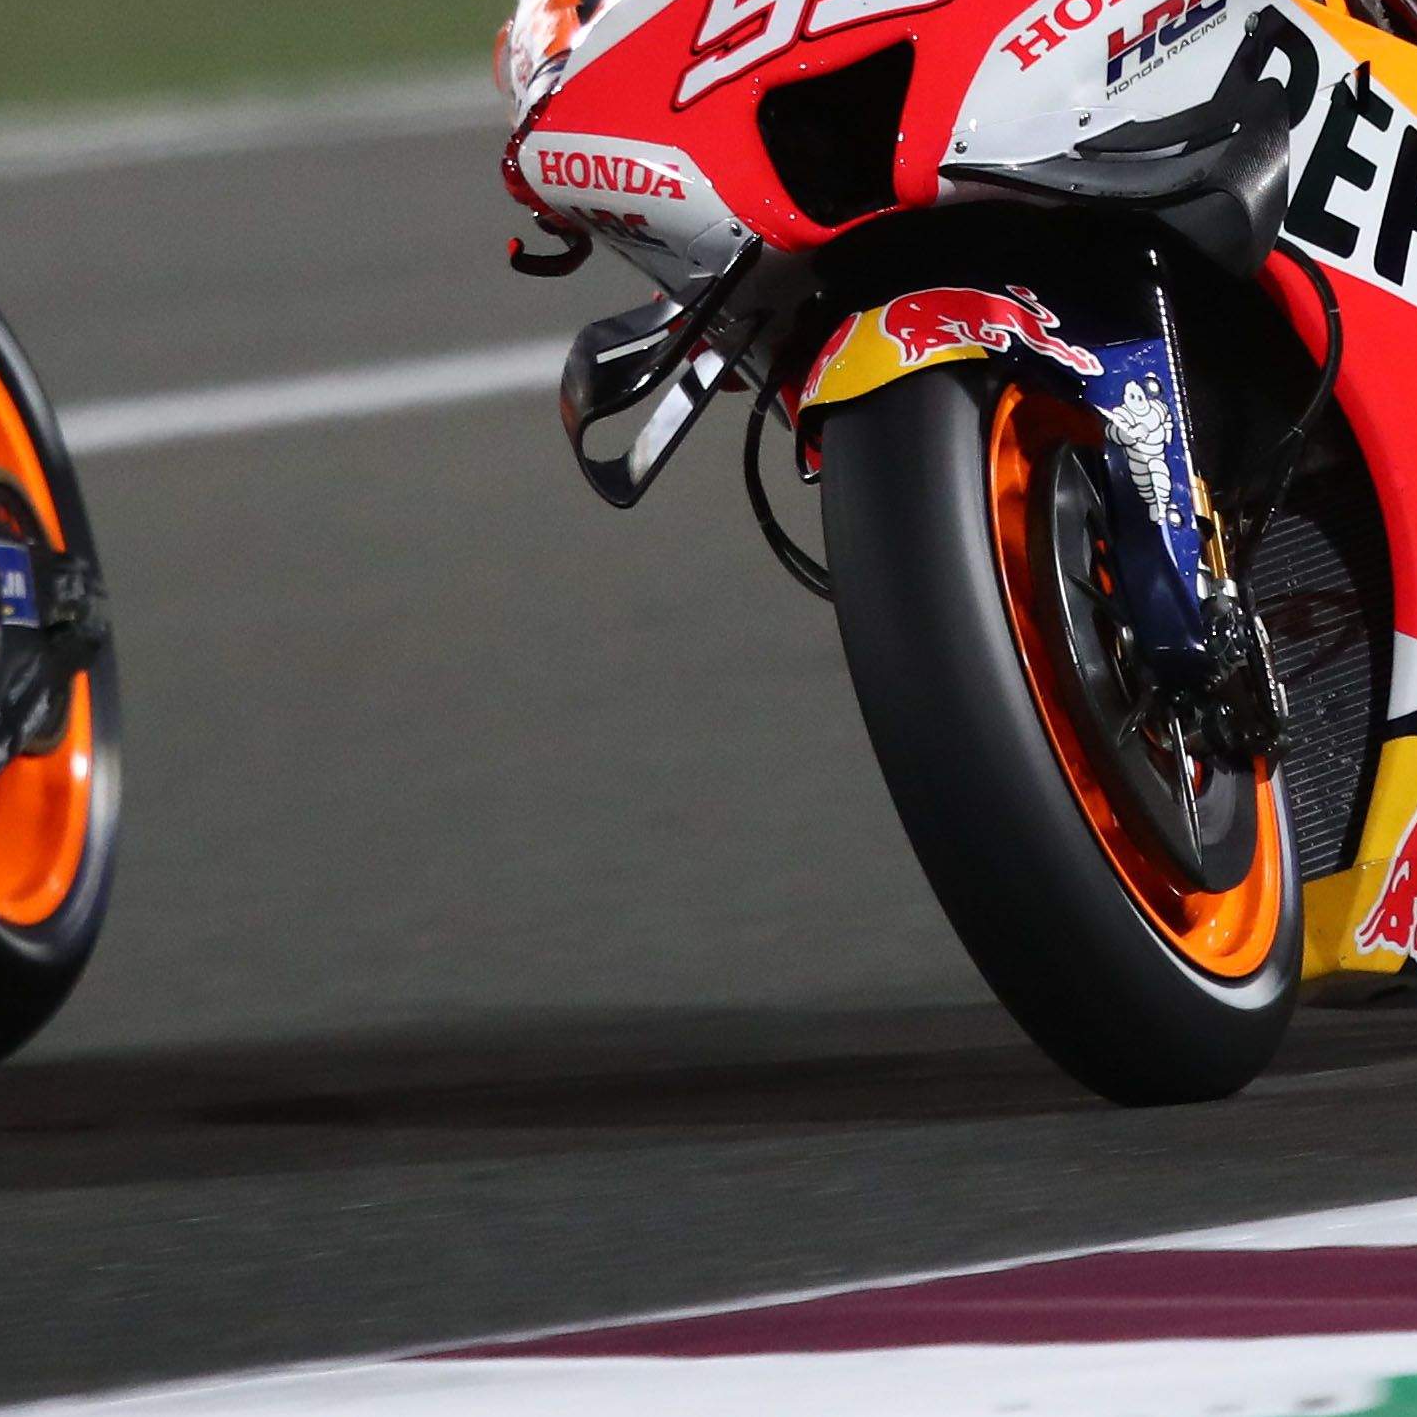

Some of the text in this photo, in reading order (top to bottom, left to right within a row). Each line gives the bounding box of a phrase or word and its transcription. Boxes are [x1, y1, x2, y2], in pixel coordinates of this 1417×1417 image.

[1106, 12, 1229, 101] Honda RACING
[537, 149, 687, 201] HONDA
